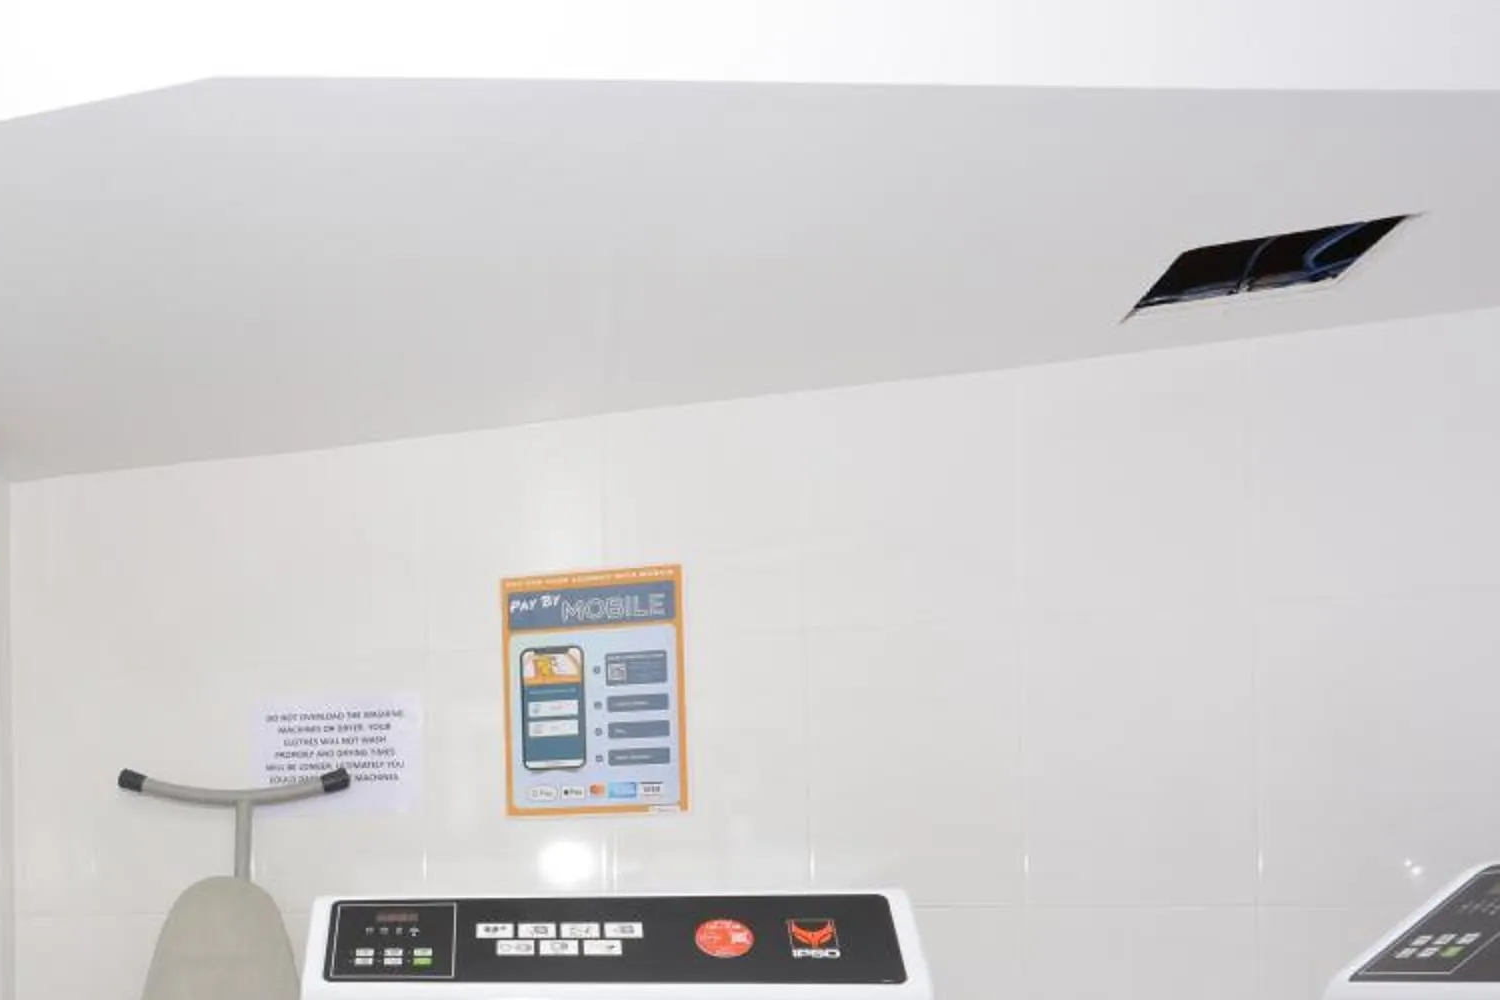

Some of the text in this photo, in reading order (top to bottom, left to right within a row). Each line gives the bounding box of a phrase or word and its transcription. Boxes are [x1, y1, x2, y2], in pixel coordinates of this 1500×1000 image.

[510, 592, 666, 623] PAY BY MOBILE
[265, 714, 278, 723] DO
[280, 713, 298, 722] NOT
[300, 711, 345, 722] OVERLOAD
[347, 710, 361, 720] THE
[277, 725, 321, 735] MACHINES
[368, 722, 391, 732] YOUR
[283, 735, 387, 747] CLOTHES WILL NOT WASH
[315, 750, 334, 758] AND
[336, 748, 368, 758] DRYING
[387, 760, 405, 769] YOU
[791, 948, 841, 959] IPSO
